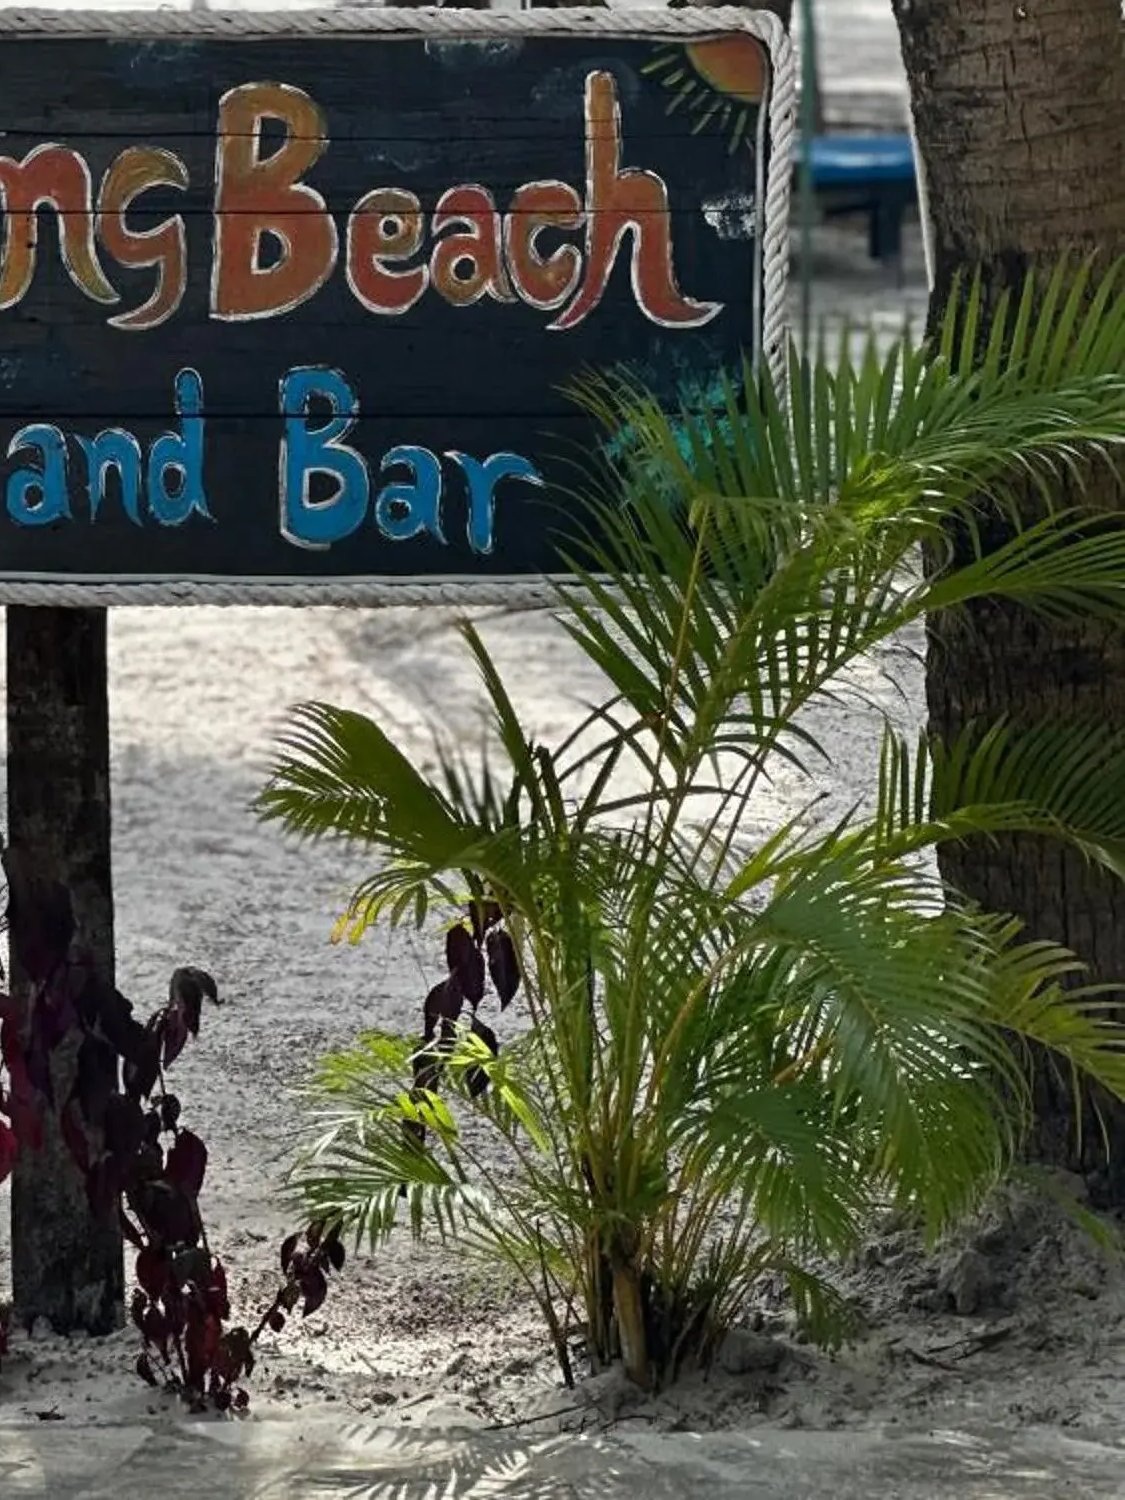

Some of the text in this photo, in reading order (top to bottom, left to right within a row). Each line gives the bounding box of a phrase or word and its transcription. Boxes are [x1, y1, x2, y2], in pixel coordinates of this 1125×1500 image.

[209, 69, 725, 330] Beach
[5, 366, 218, 528] and
[278, 365, 546, 555] Bar
